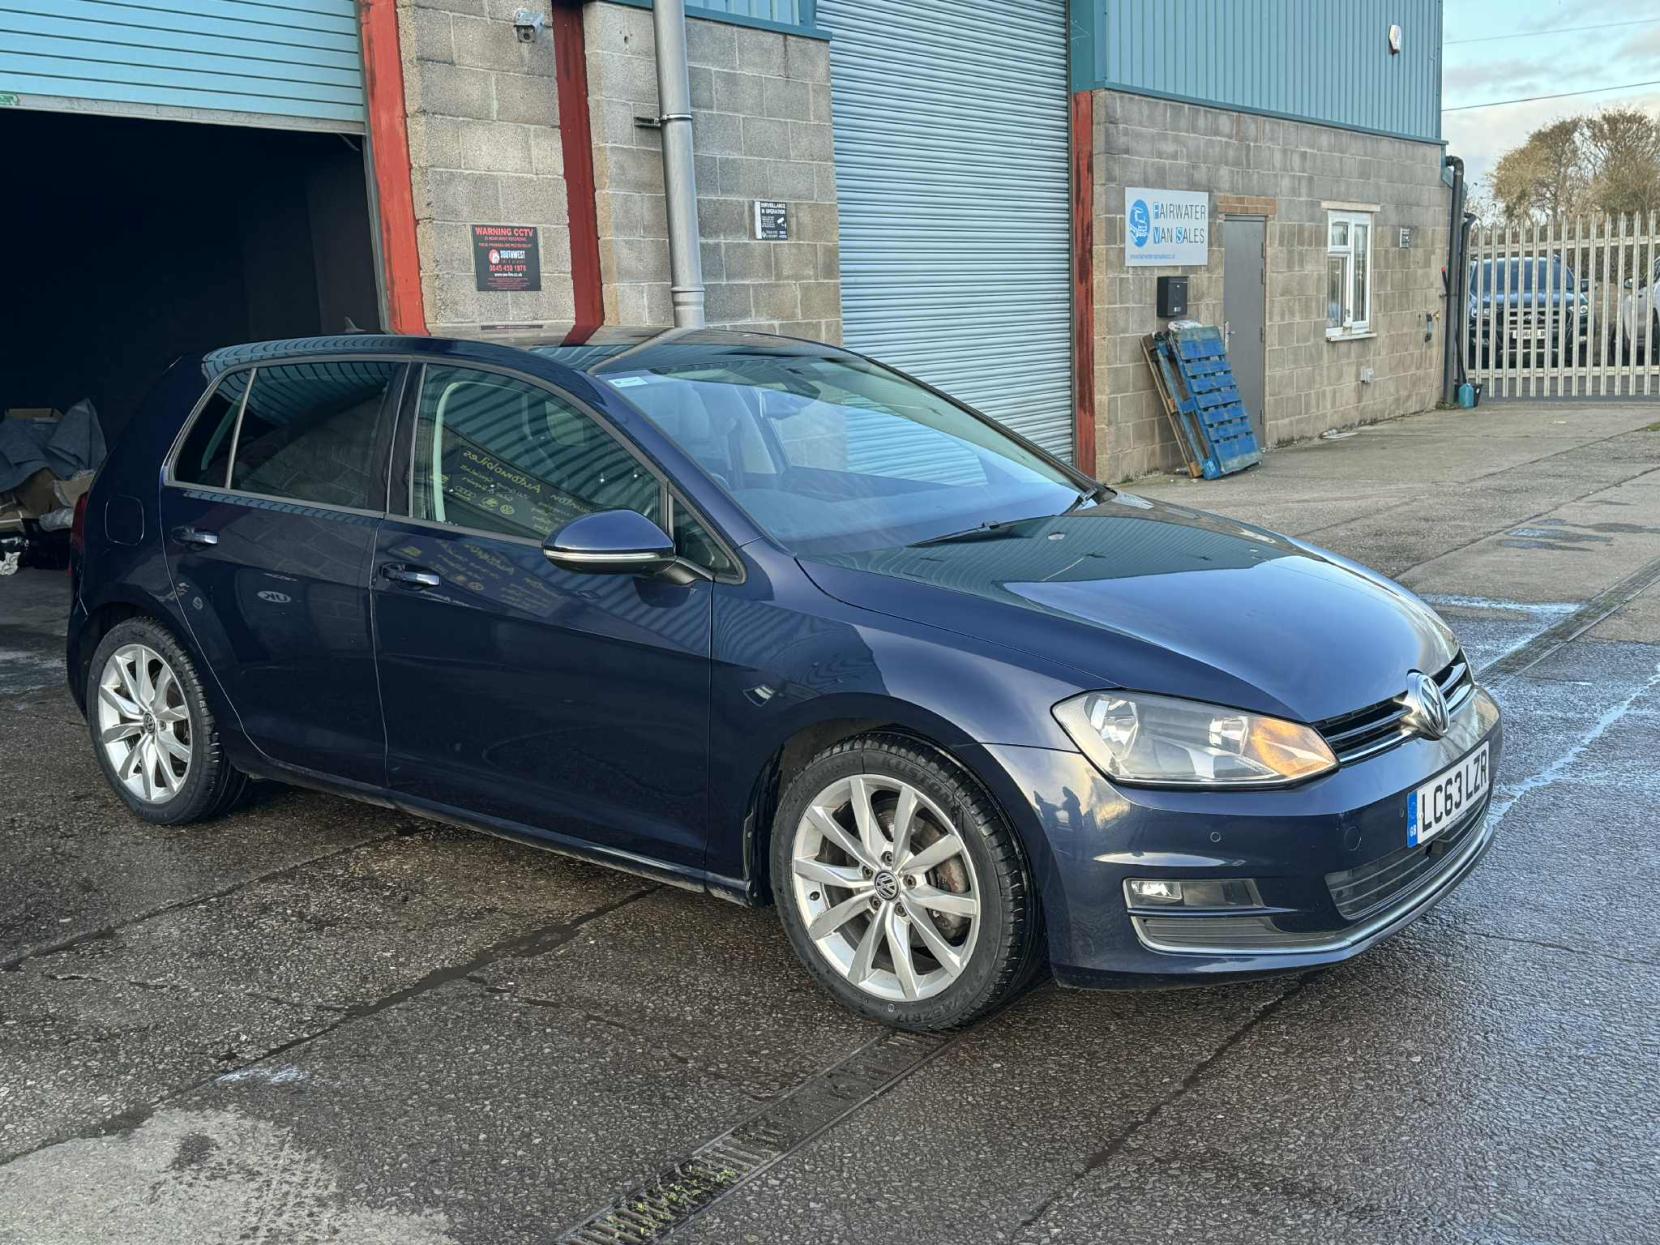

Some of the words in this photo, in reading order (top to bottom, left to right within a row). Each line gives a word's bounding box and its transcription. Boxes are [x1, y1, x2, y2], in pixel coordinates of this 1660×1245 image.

[1153, 202, 1206, 221] FAIRWATER
[475, 226, 512, 236] WARNING
[514, 228, 533, 236] CCTV
[1153, 226, 1173, 244] VAN
[1175, 226, 1205, 244] SALES
[1422, 770, 1463, 832] LC63
[1466, 749, 1487, 801] LZR
